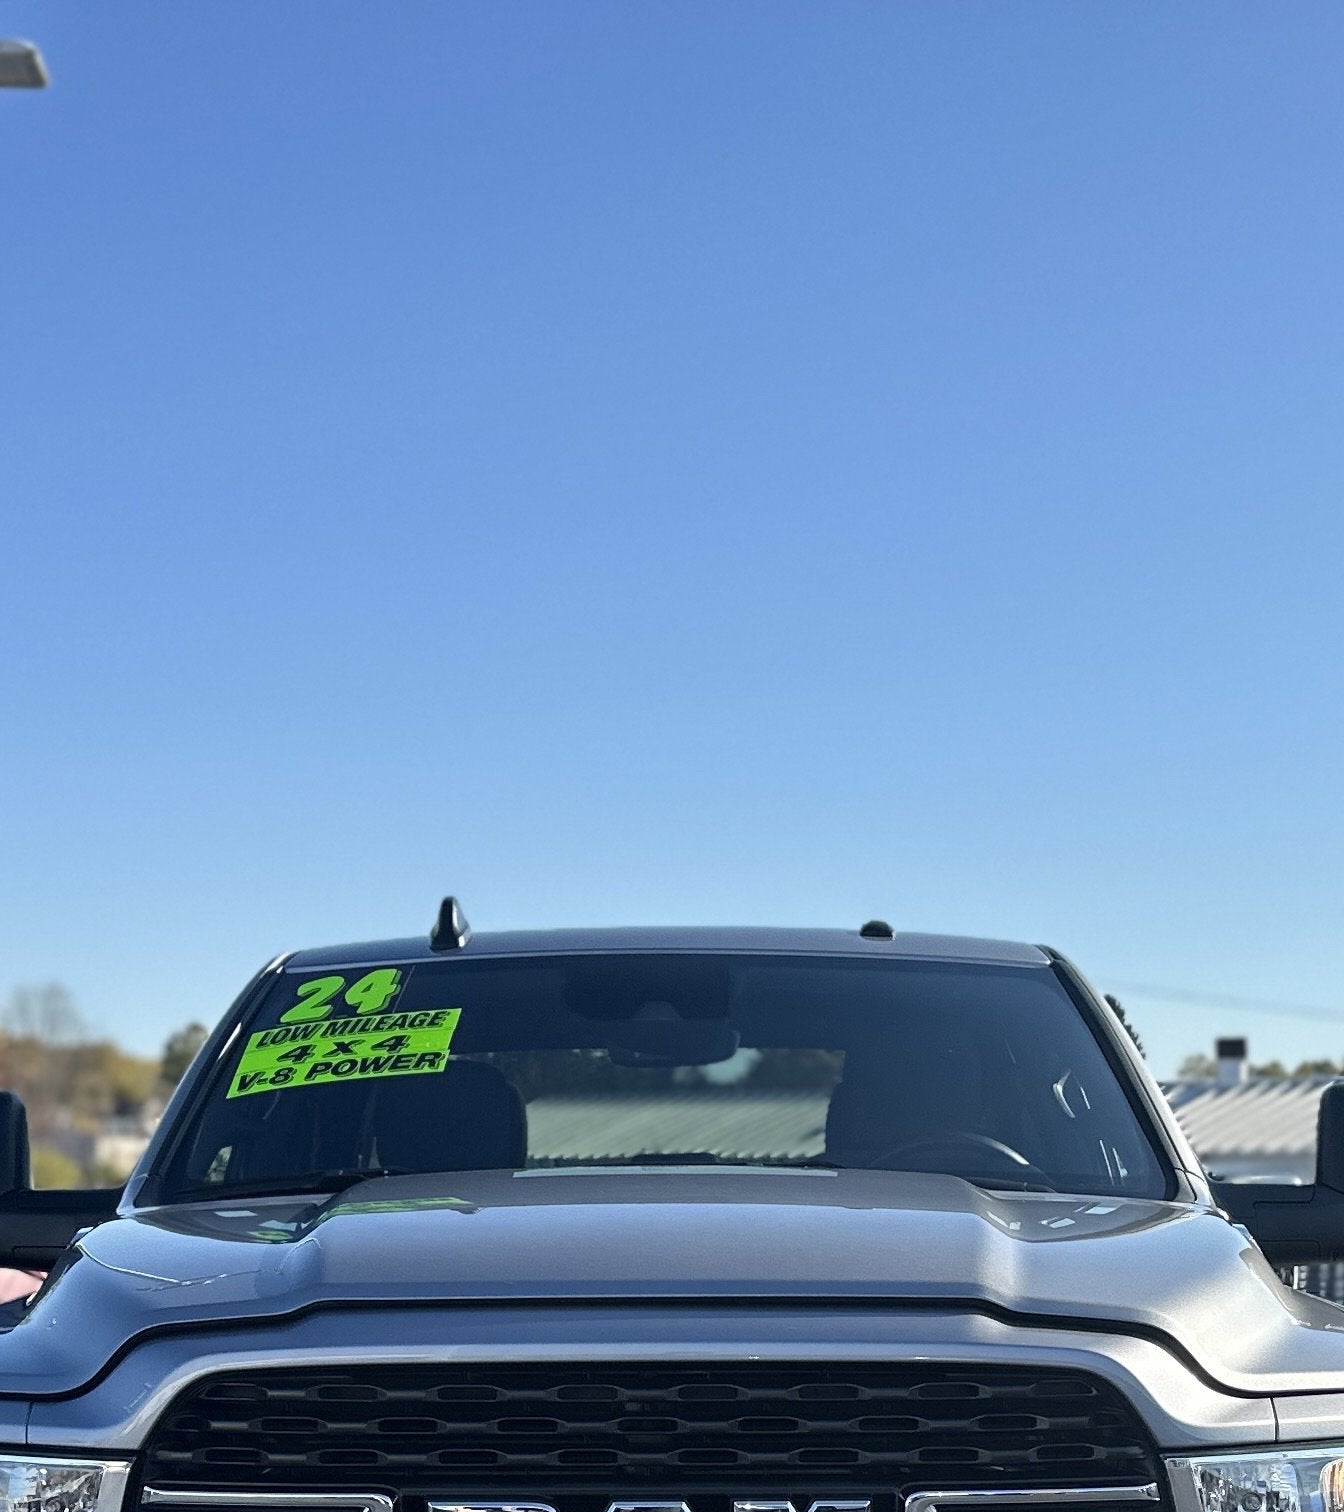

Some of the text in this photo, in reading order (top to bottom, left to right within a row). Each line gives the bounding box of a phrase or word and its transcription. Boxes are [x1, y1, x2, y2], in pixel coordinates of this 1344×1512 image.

[280, 968, 402, 1023] 24
[257, 1010, 449, 1049] LOW MILEAGE
[277, 1044, 315, 1064] 4
[371, 1034, 412, 1053] 4
[236, 1050, 446, 1093] V-8 POWER
